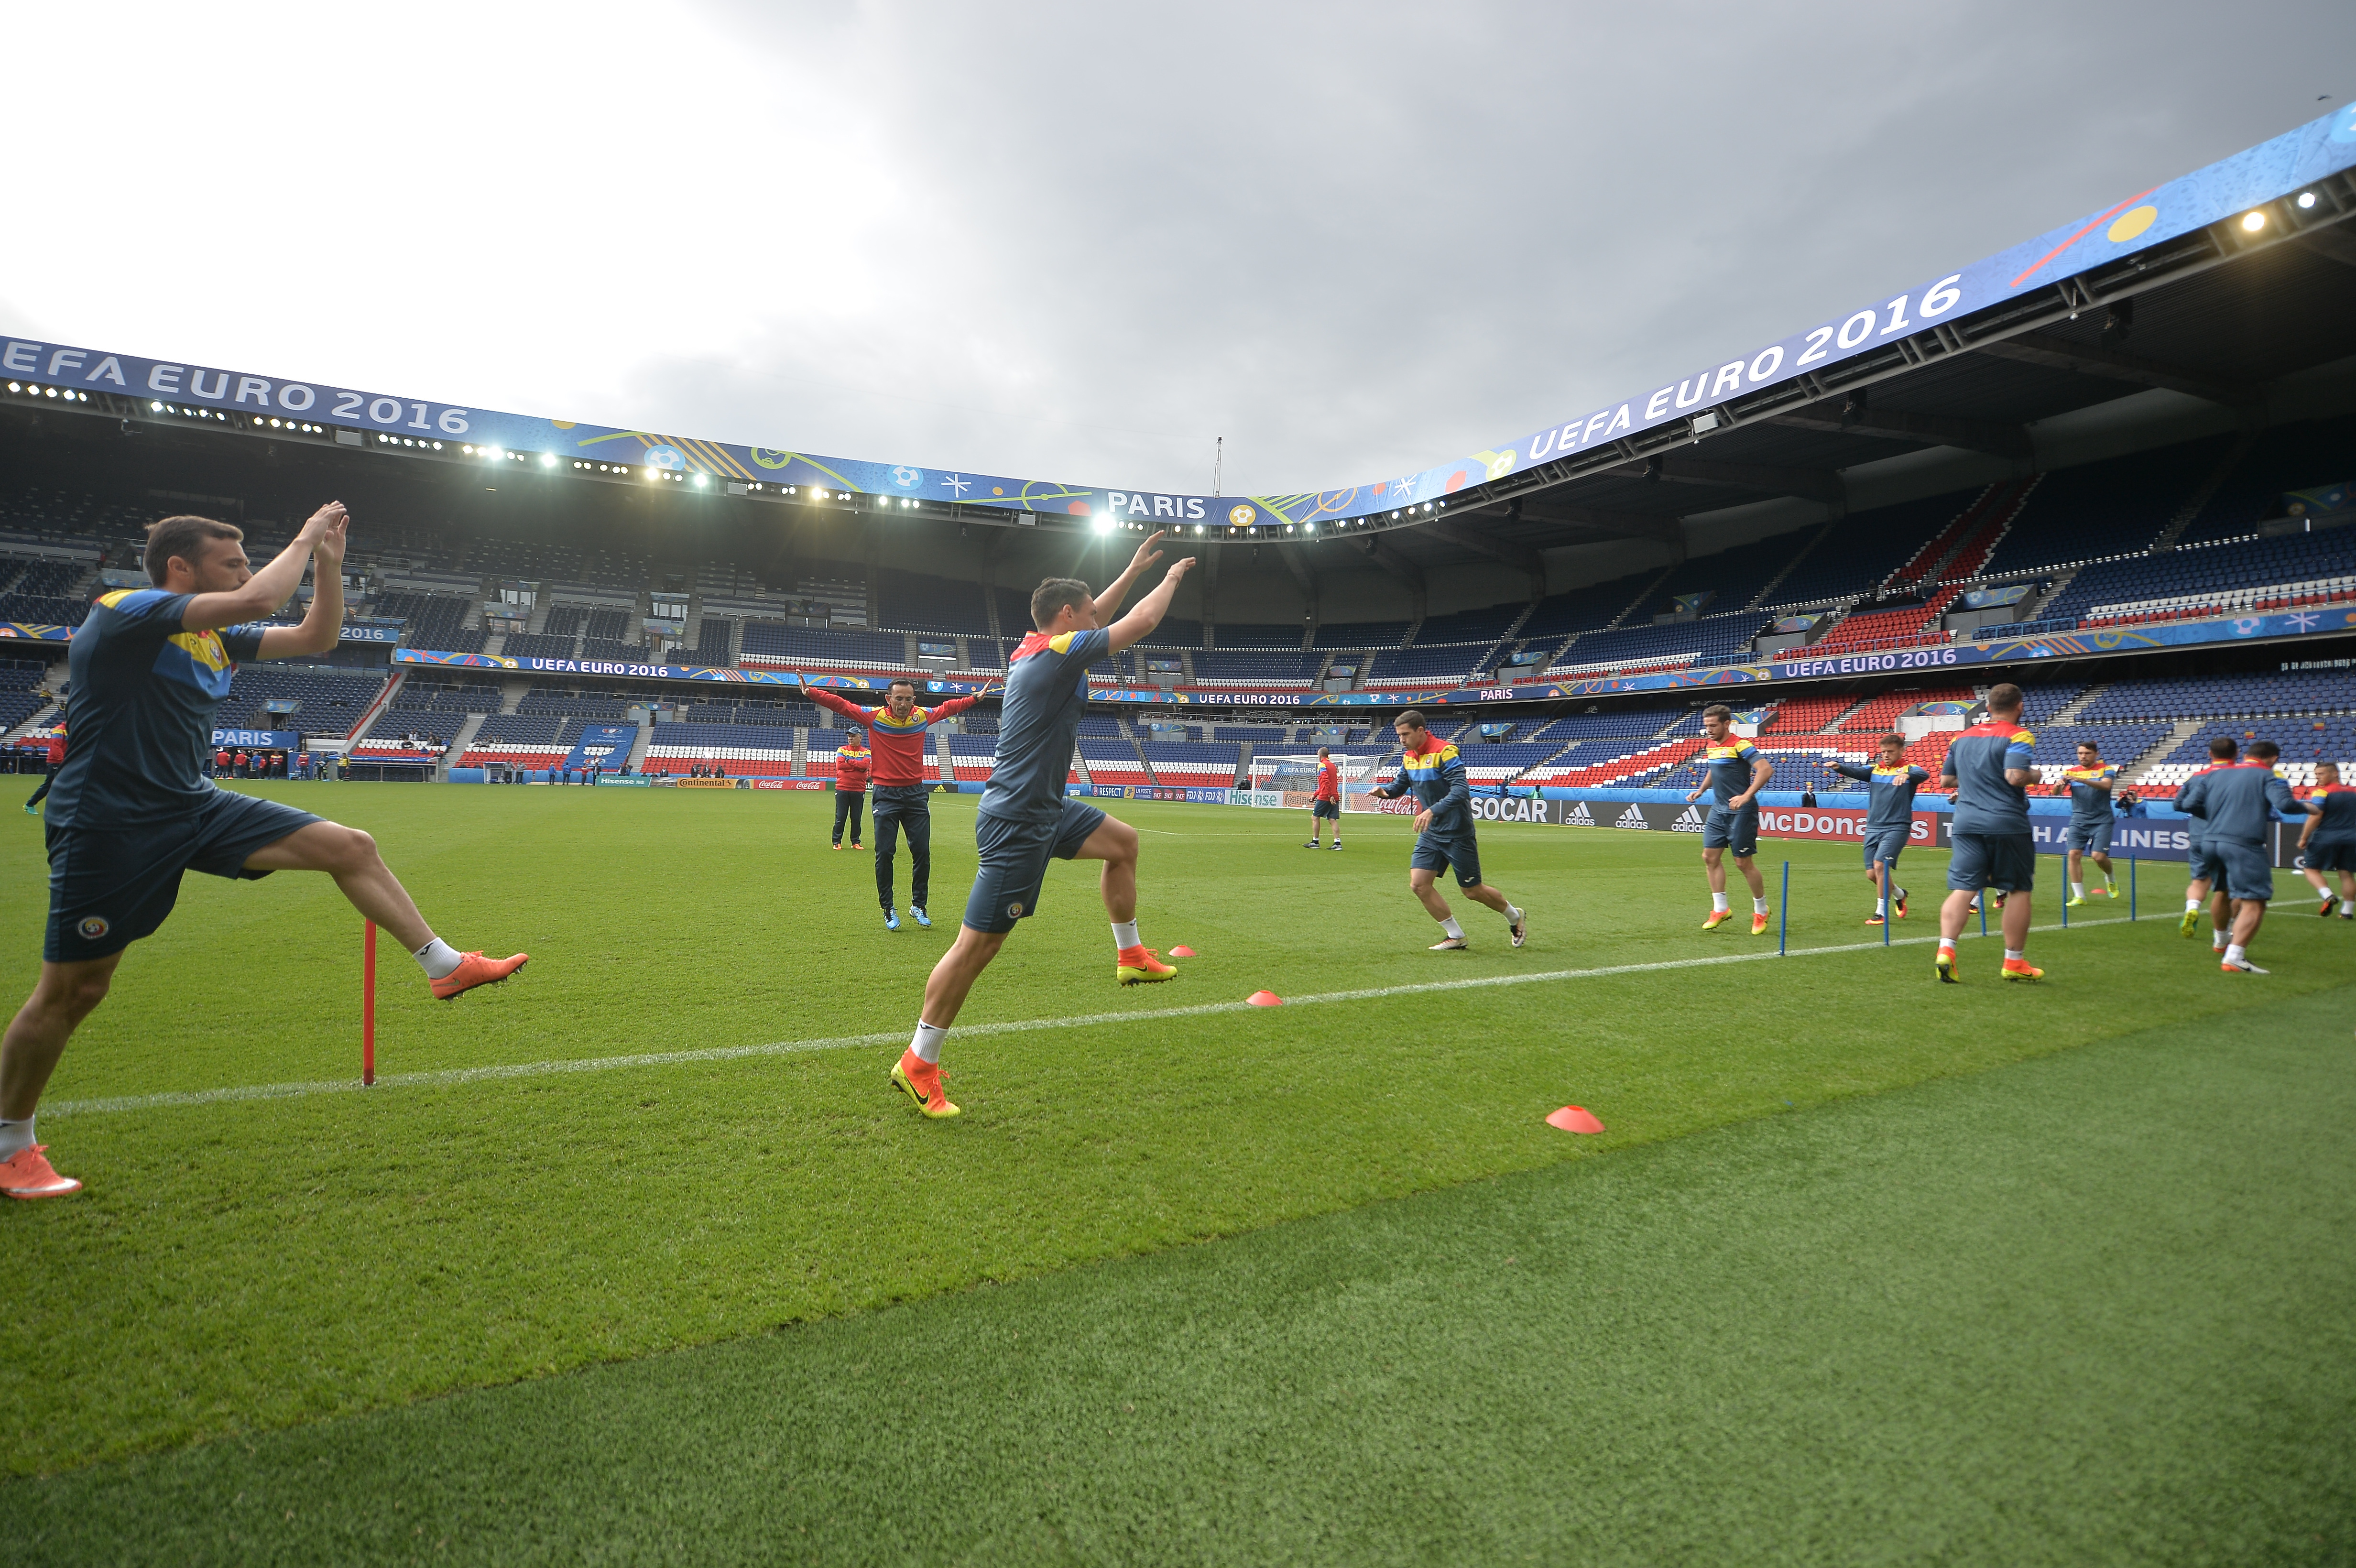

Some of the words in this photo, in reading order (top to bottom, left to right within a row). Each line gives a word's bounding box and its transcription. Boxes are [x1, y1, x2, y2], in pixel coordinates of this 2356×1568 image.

[1528, 403, 1630, 460] UEFA
[1644, 345, 1784, 421] EURO
[1796, 273, 1962, 366] 2016
[148, 365, 316, 411] EURO
[331, 392, 469, 434] 2016
[1108, 492, 1205, 519] PARIS
[340, 627, 383, 640] 2016
[532, 658, 577, 672] UEFA
[580, 661, 624, 675] EURO
[628, 664, 668, 677] 2016
[1786, 661, 1835, 677] UEFA
[1841, 655, 1896, 673] EURO
[1901, 649, 1957, 667] 2016
[1199, 694, 1231, 703] UEFA
[1234, 695, 1267, 704] EURO
[1269, 695, 1300, 705] 2016
[1480, 688, 1513, 700] PARIS
[211, 731, 273, 745] PARIS
[679, 779, 724, 787] Continental
[1100, 787, 1121, 796] RESPECT
[1186, 791, 1196, 799] FDJ
[1205, 792, 1215, 801] FDJ
[1471, 797, 1547, 823] SOCAR
[1565, 817, 1595, 827] adidas
[1615, 819, 1648, 829] adidas
